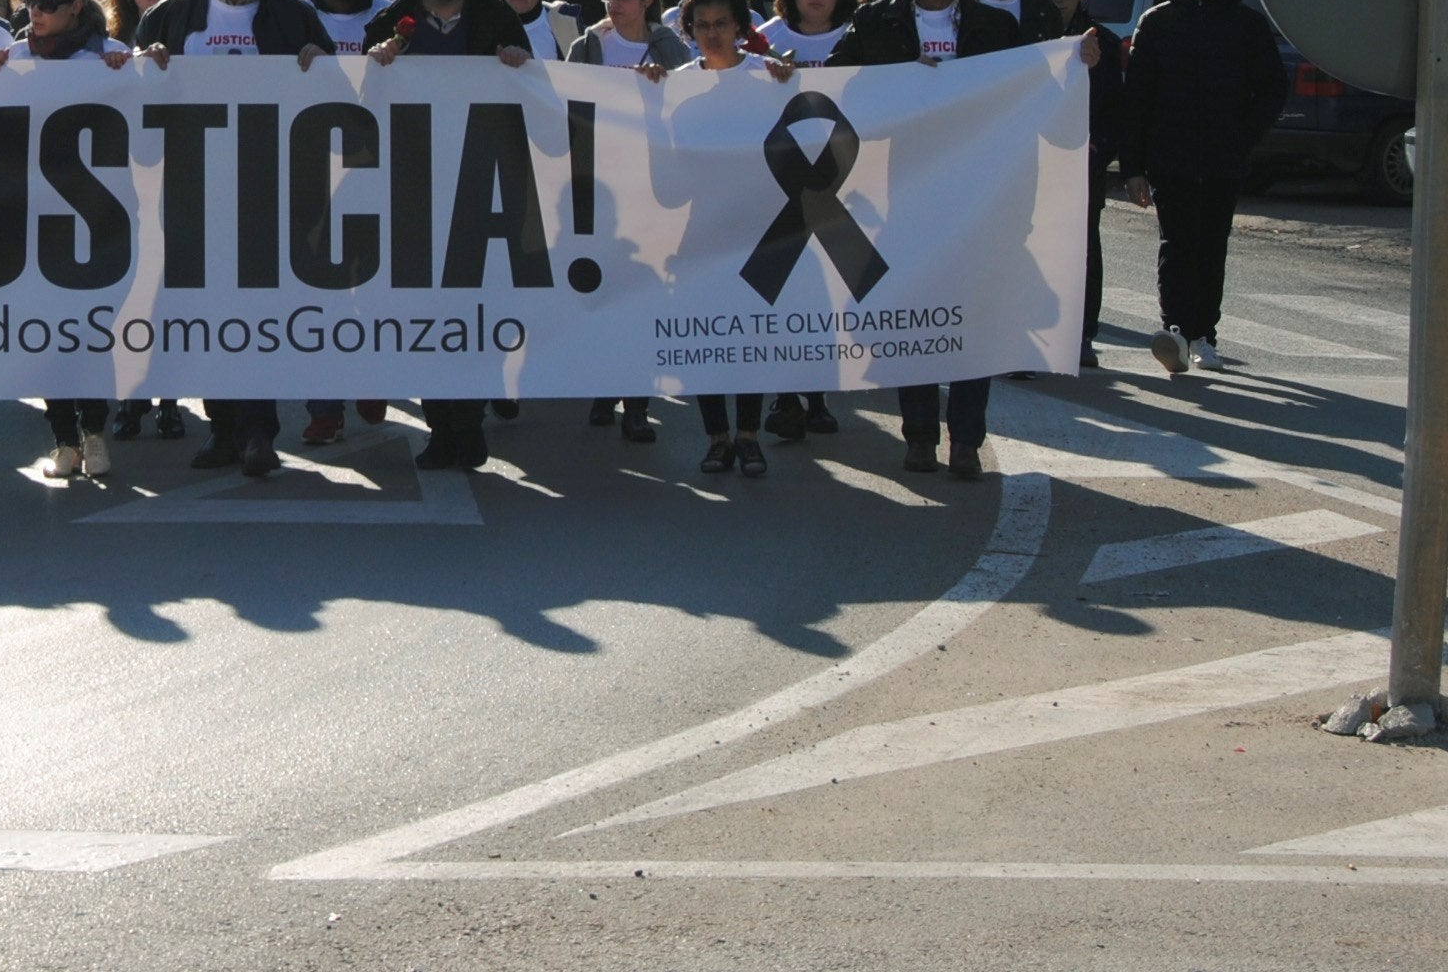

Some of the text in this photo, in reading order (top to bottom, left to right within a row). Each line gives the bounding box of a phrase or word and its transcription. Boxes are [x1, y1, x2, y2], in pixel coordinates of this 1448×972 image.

[206, 34, 256, 46] JUSTICI
[923, 41, 955, 53] STICI
[655, 305, 963, 339] NUNCA TE OLVIDAREMOS
[656, 334, 963, 366] SIEMPRE EN NUESTRO CORAZÓN
